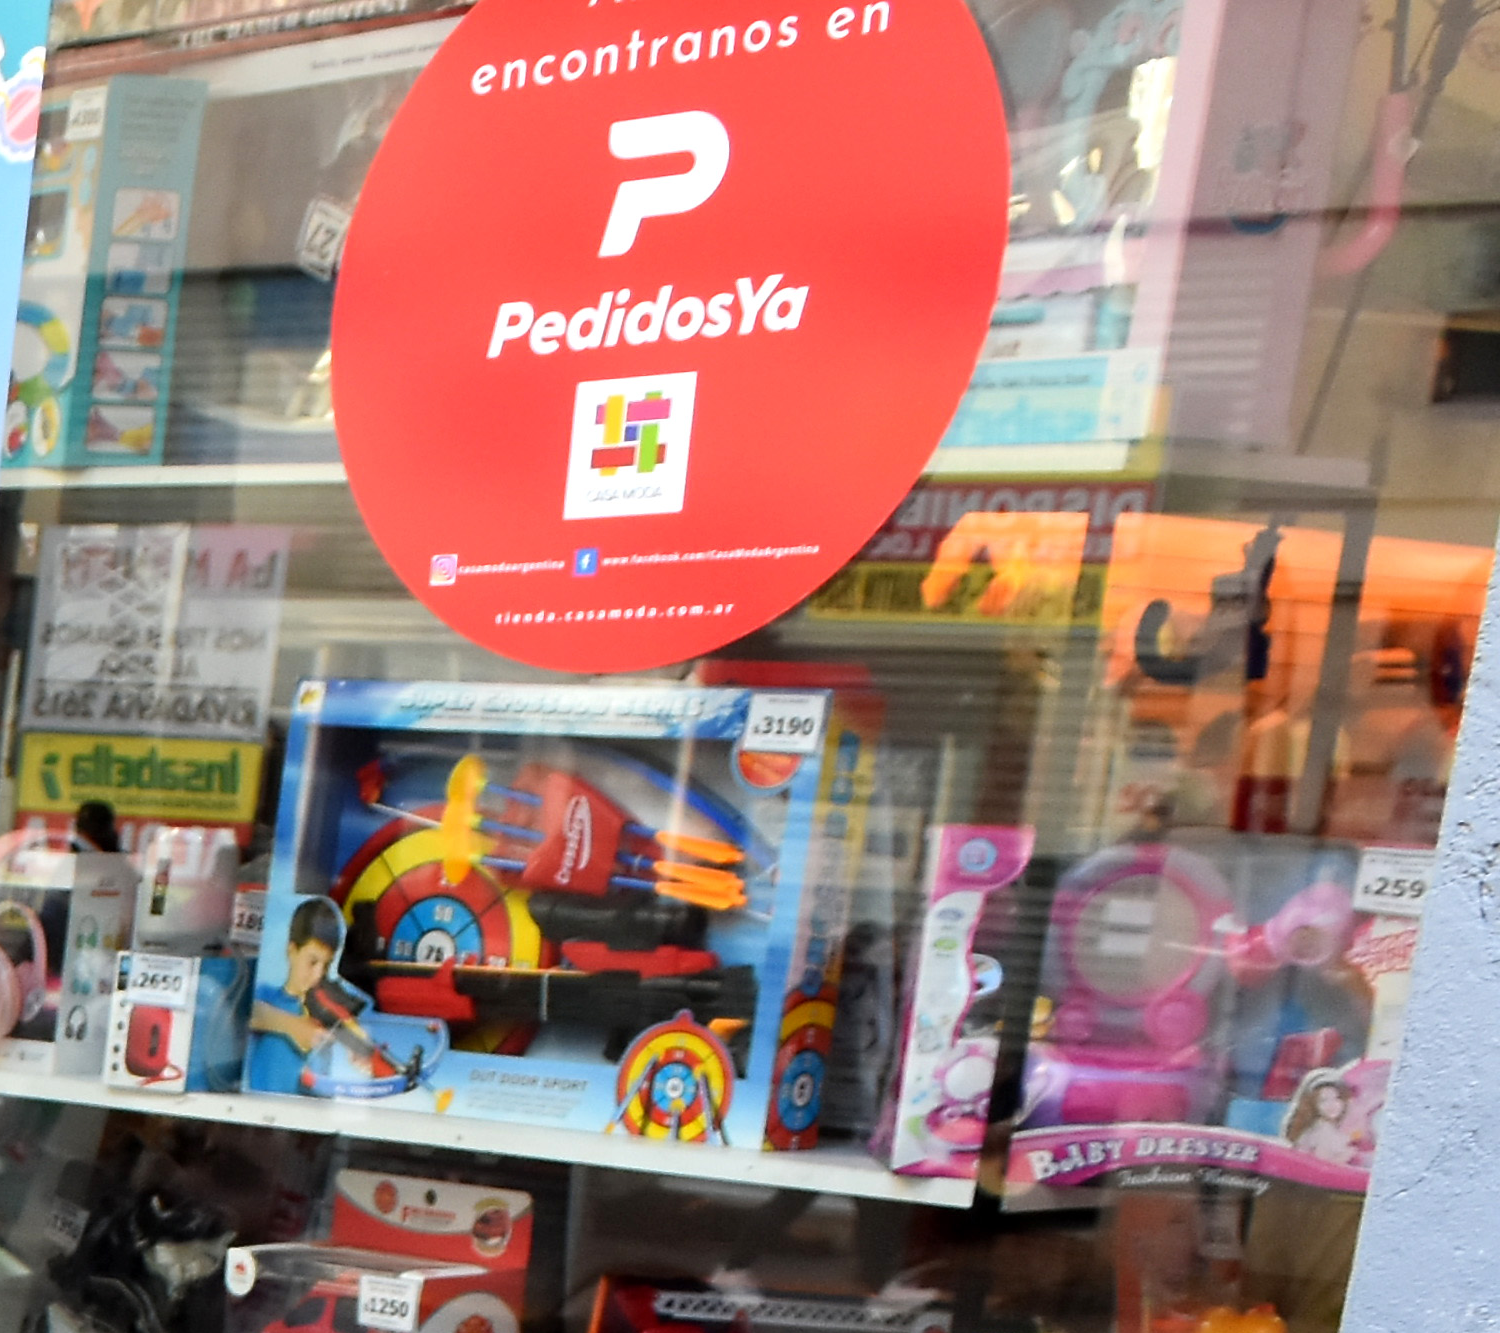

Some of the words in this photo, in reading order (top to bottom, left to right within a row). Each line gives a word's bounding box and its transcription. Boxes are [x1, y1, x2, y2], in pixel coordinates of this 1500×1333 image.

[471, 15, 798, 95] encontranos
[826, 0, 890, 40] en
[486, 273, 810, 360] PedidosYa
[753, 714, 814, 737] $3190
[132, 972, 183, 991] $2650
[1028, 1138, 1125, 1182] BABY
[1134, 1136, 1261, 1165] DRESSER
[364, 1298, 410, 1318] $1250
